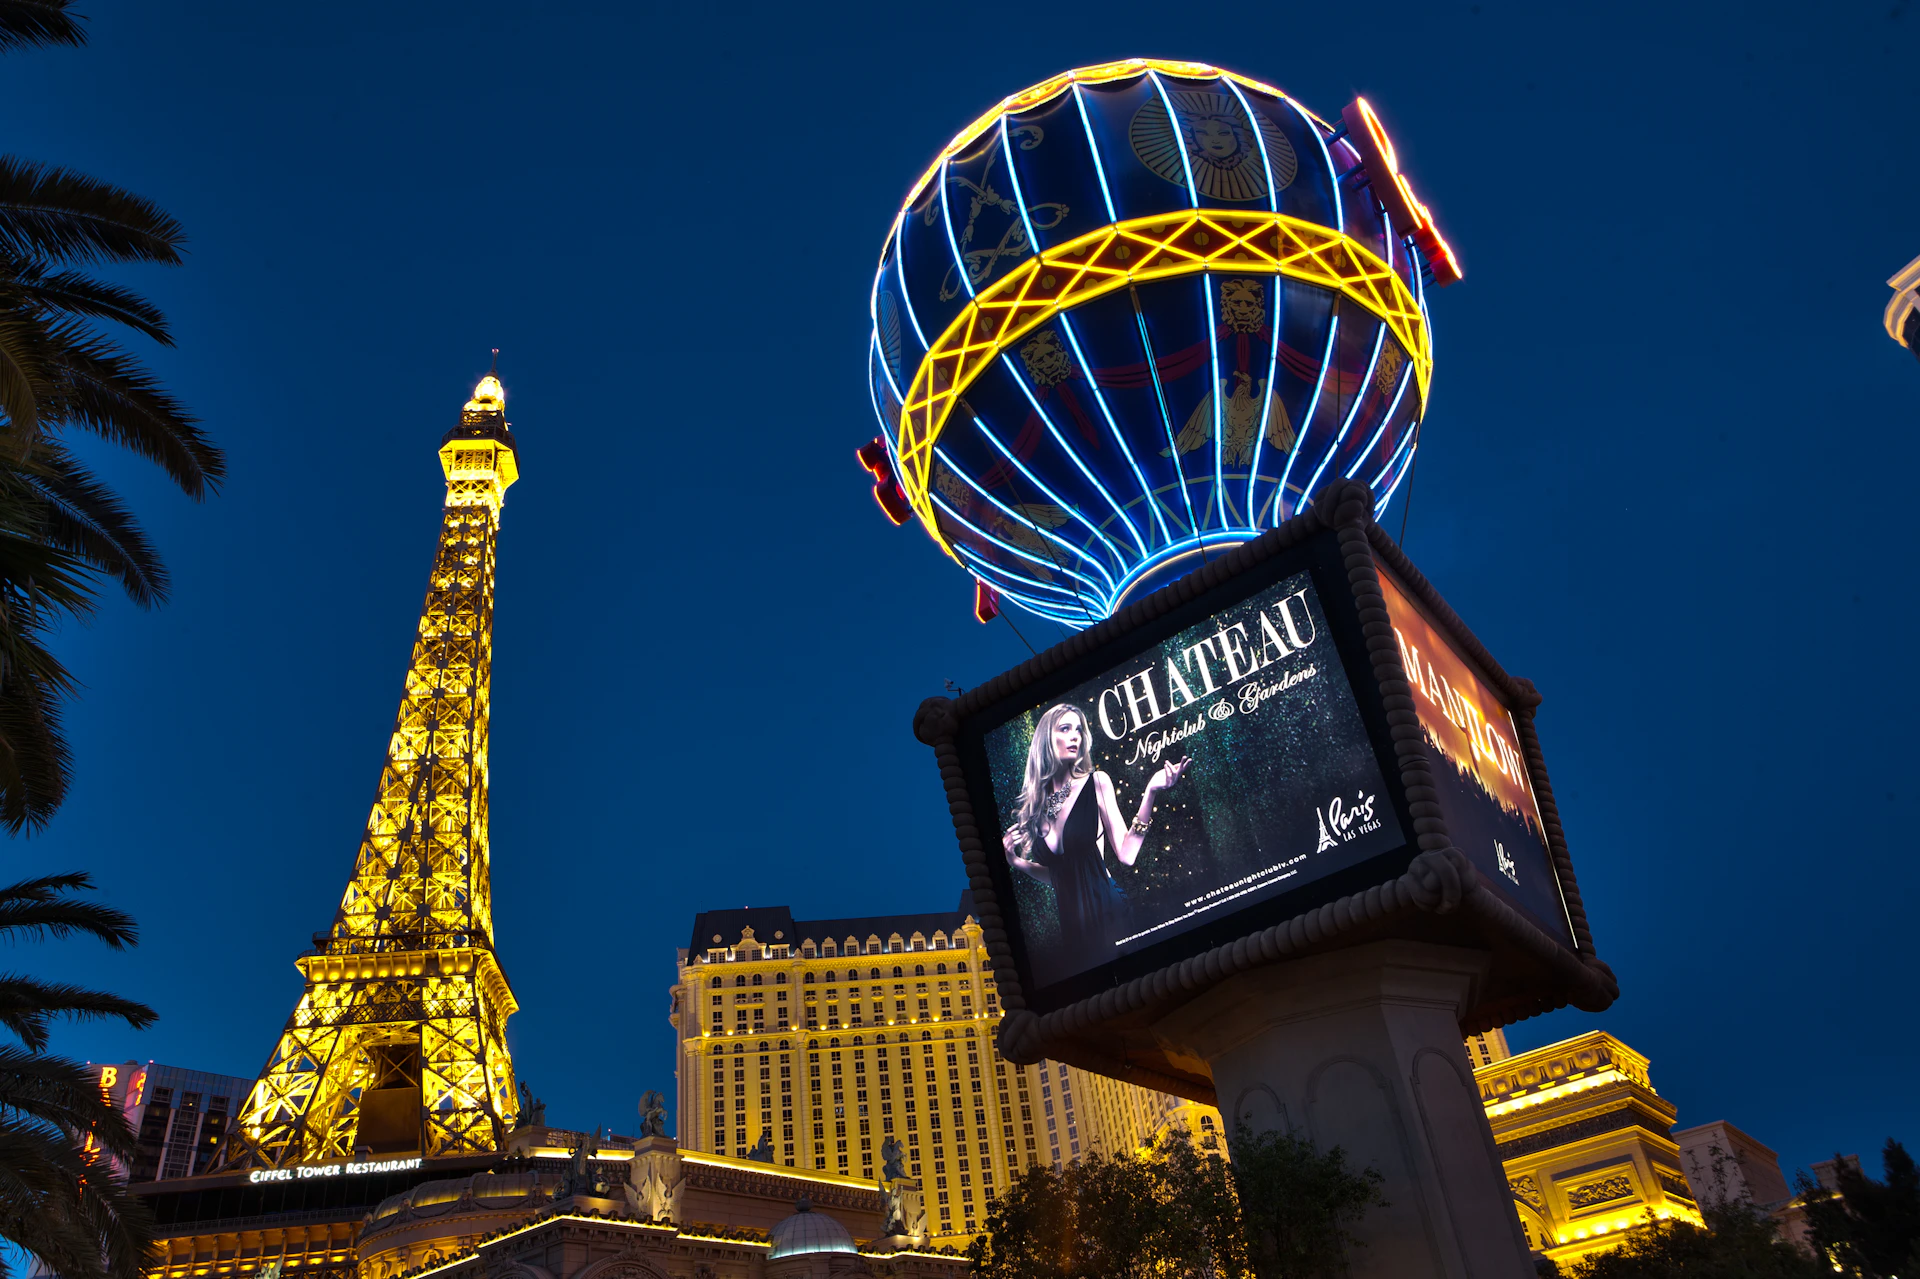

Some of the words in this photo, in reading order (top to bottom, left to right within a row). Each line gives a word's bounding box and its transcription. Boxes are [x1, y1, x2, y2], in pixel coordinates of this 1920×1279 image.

[1098, 589, 1317, 741] CHATEAU
[1124, 713, 1206, 765] Nightclub
[1208, 698, 1235, 721] &
[1237, 662, 1317, 714] Gardens
[1394, 627, 1525, 792] MANILOW
[1328, 789, 1375, 837] Paris
[1343, 829, 1357, 842] LAS
[1358, 818, 1382, 835] VEGAS
[1184, 853, 1307, 908] www.chateaunightclublv.com
[250, 1169, 293, 1184] EIFFEL
[296, 1164, 341, 1179] TOWER
[346, 1158, 423, 1174] RESTAURANT
